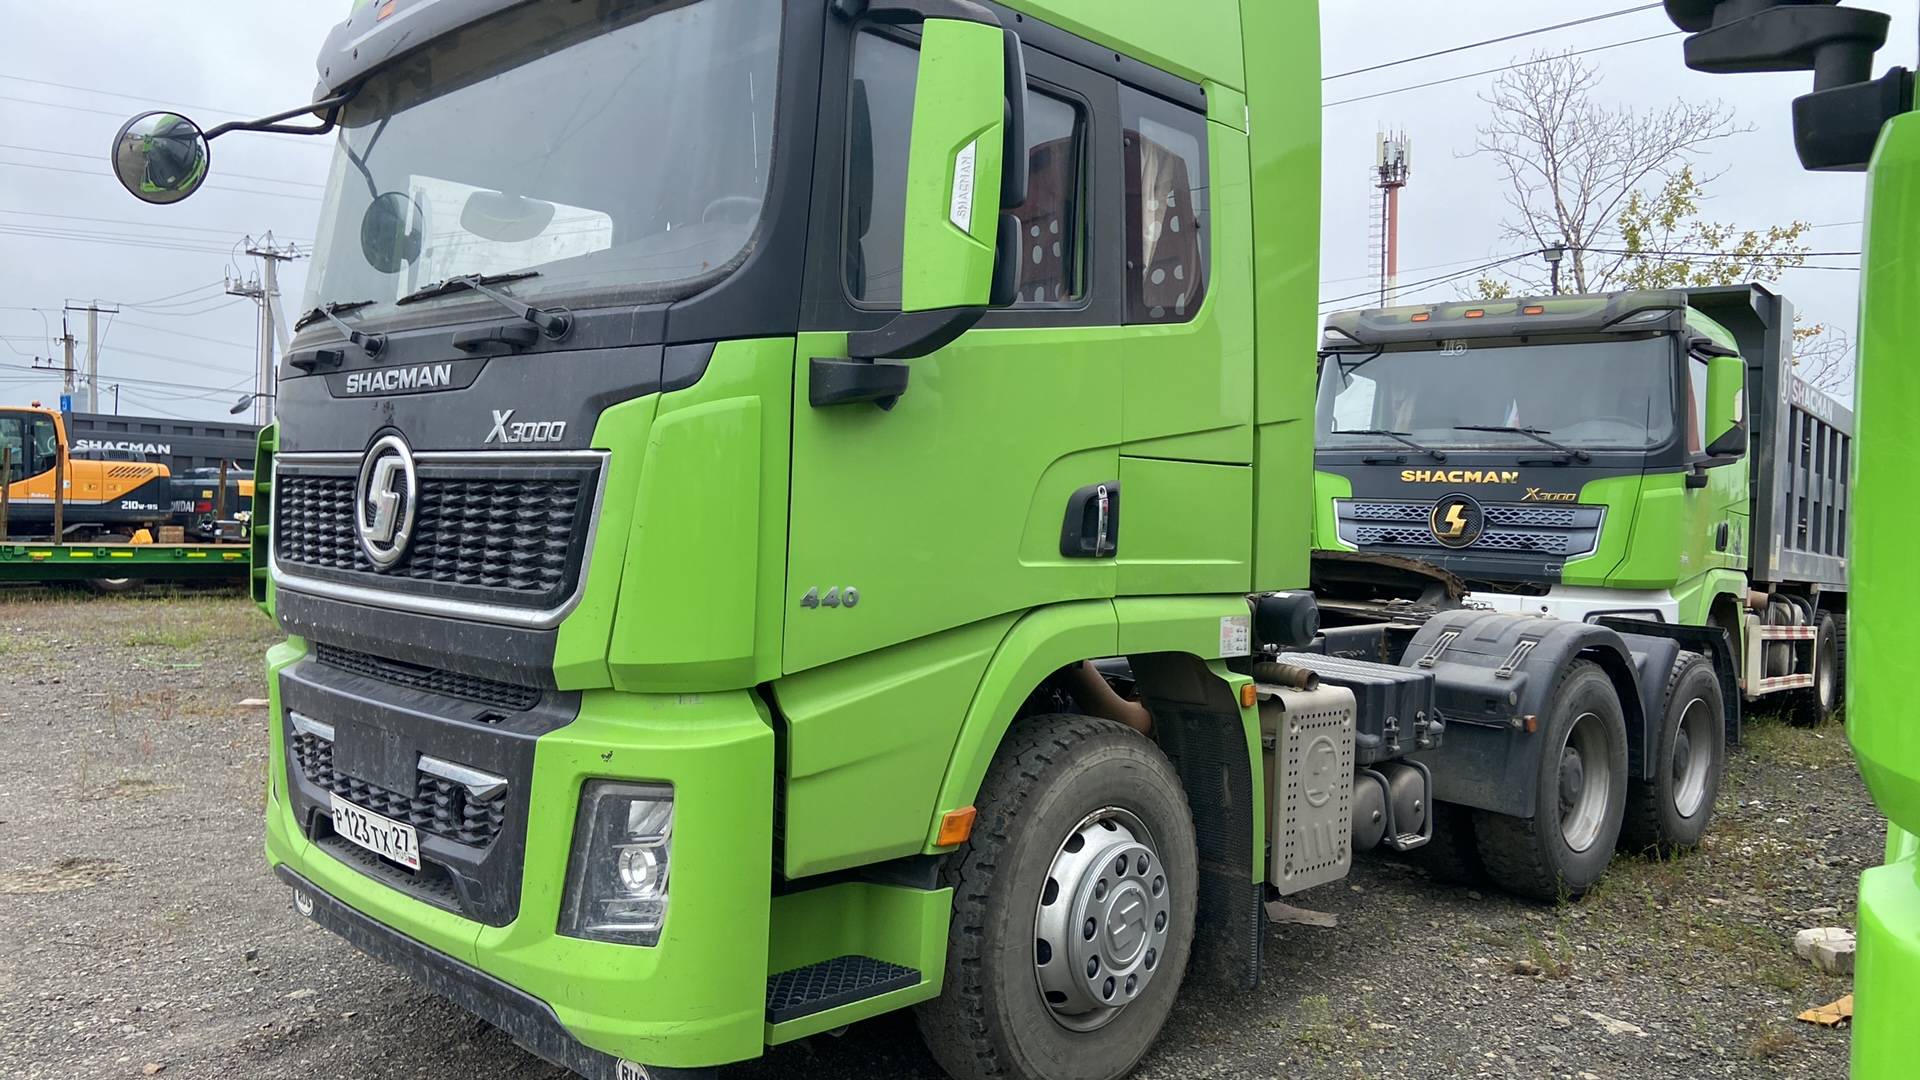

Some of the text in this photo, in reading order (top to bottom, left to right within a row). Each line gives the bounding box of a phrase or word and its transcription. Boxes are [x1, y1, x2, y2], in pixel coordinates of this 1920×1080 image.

[346, 363, 452, 393] SHACMAN
[1792, 379, 1833, 422] SHACMAN
[484, 409, 566, 443] X3000
[76, 439, 171, 454] SHACMAN
[1401, 470, 1519, 484] SHACMAN
[1521, 487, 1577, 501] X3000
[800, 586, 859, 609] 440
